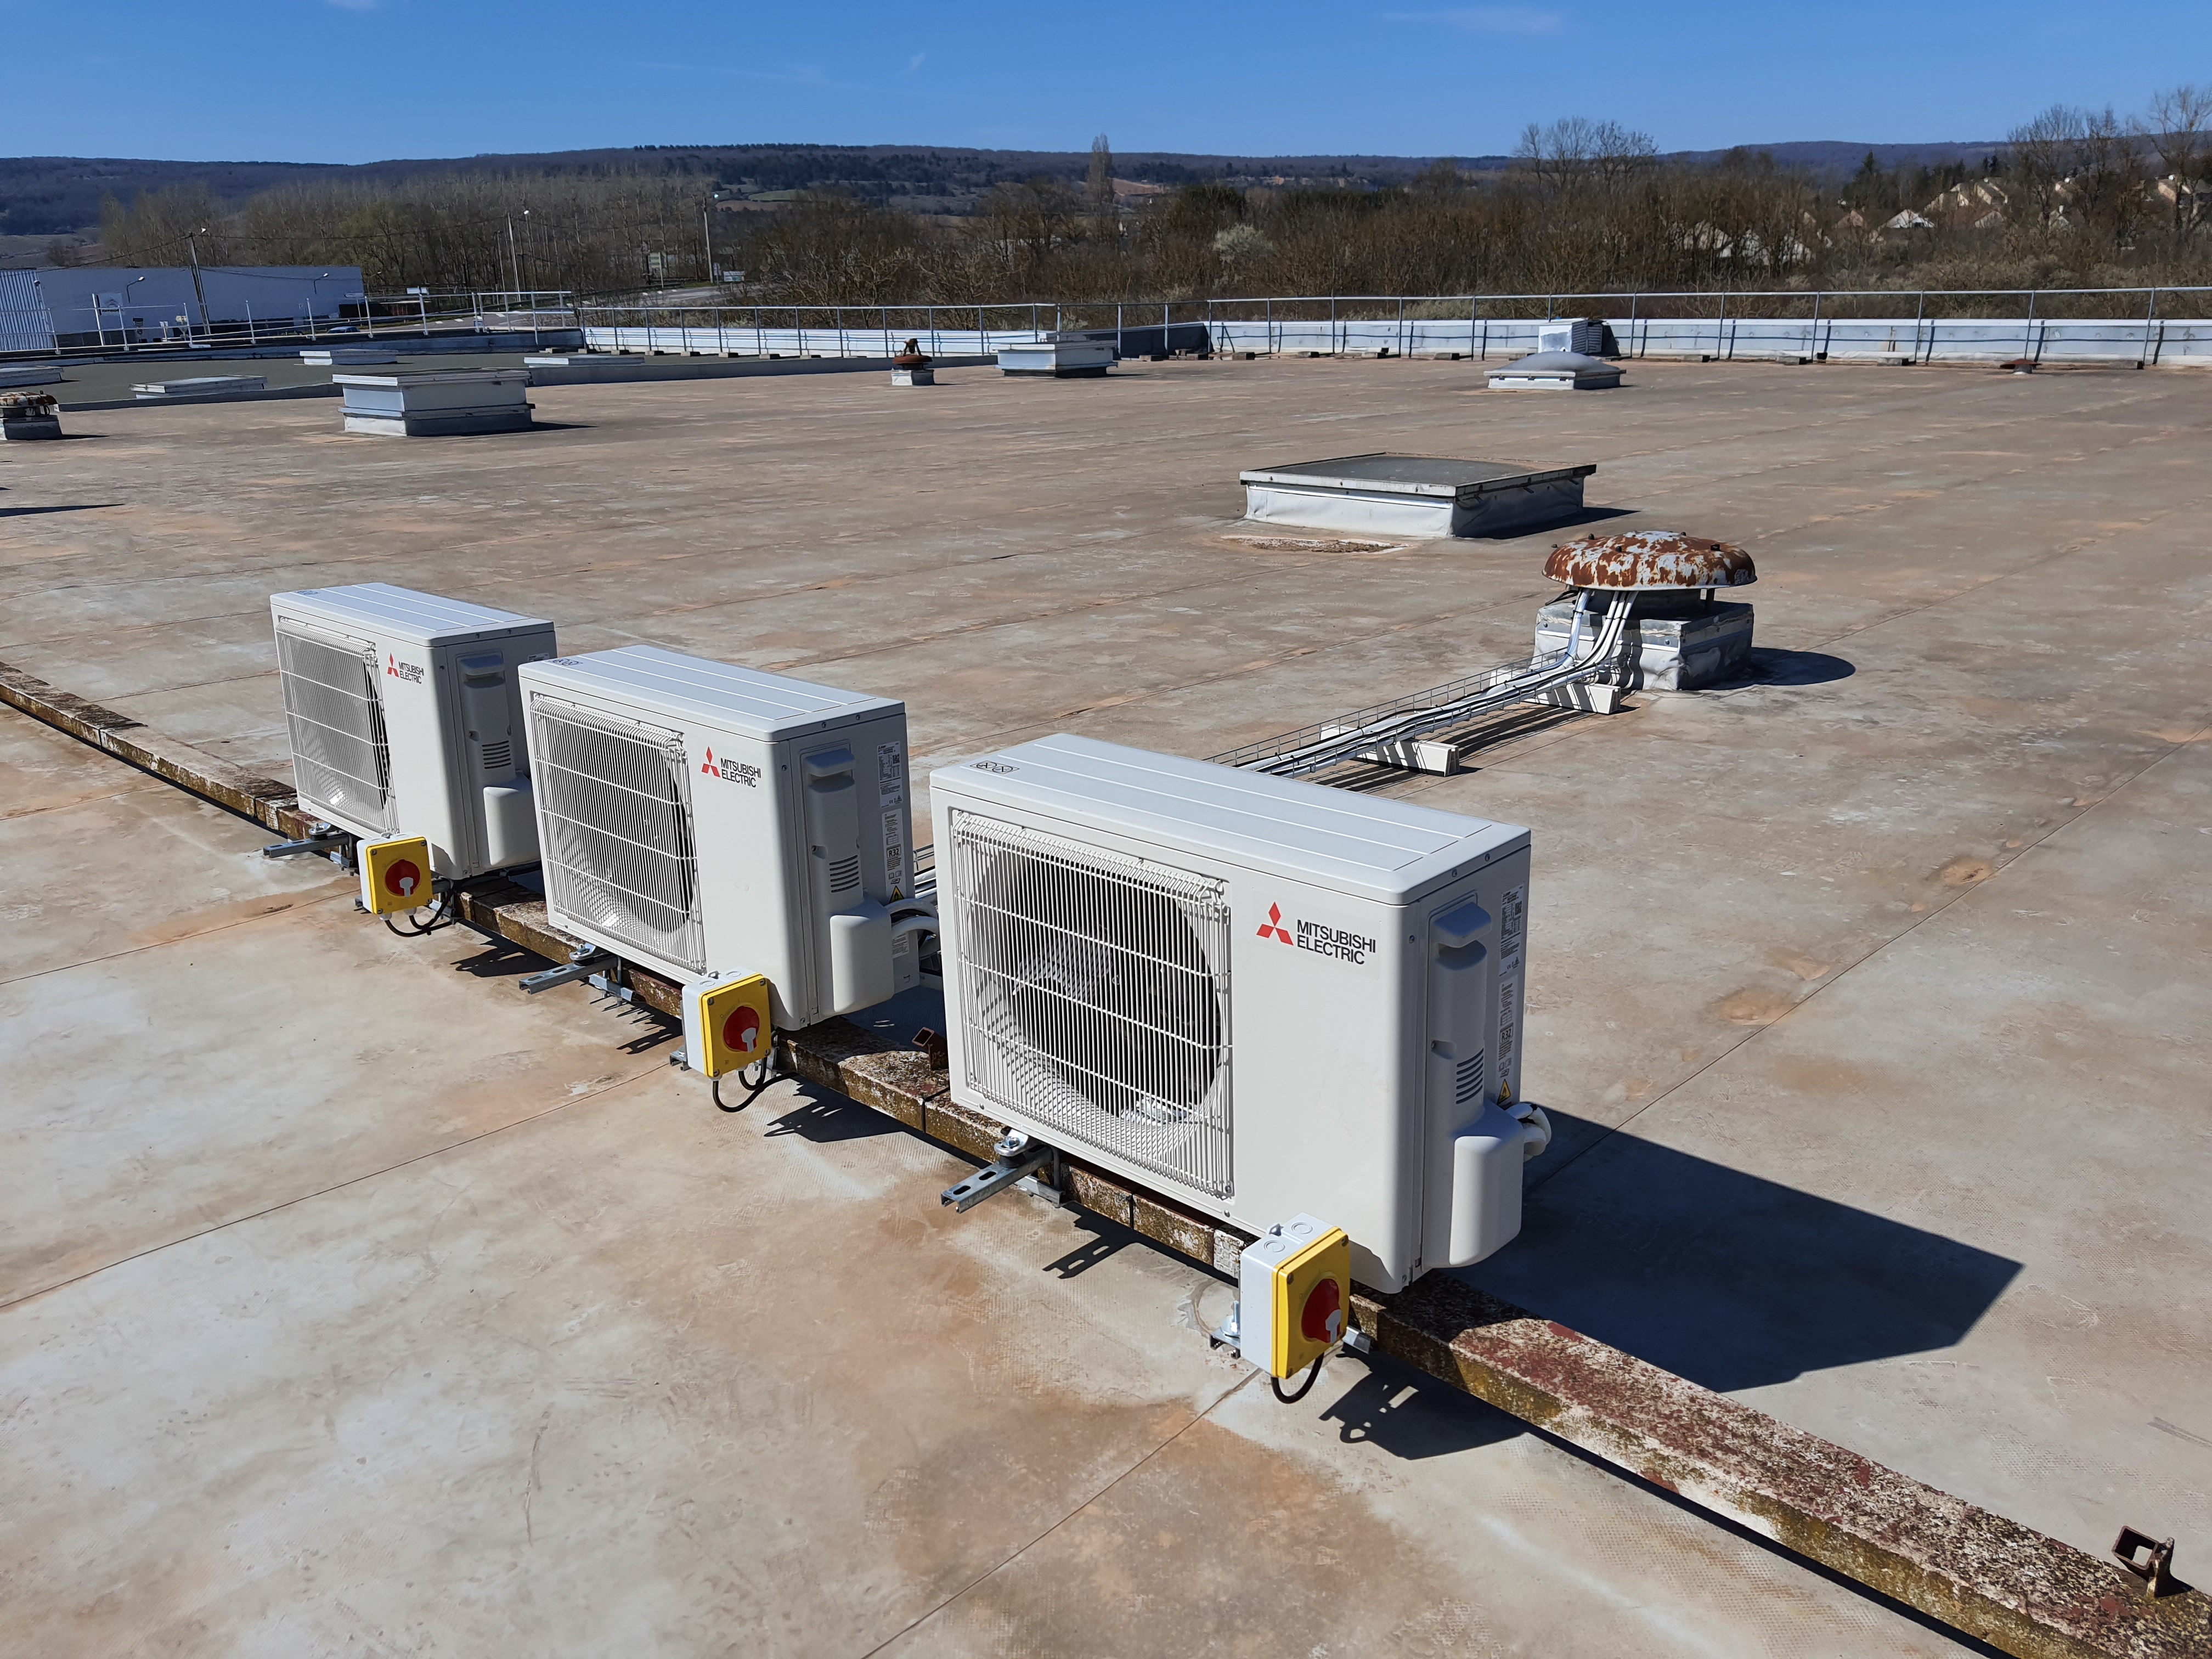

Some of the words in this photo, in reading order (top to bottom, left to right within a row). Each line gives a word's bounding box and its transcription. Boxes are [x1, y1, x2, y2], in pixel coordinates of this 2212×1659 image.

[398, 661, 424, 676] MITSUBISHI
[399, 670, 422, 684] ELECTRIC
[720, 758, 761, 778] MITSUBISHI
[721, 769, 757, 788] ELECTRIC
[889, 848, 900, 857] R32
[1297, 919, 1376, 953] MITSUBISHI
[1297, 934, 1365, 965] ELECTRIC
[1502, 1028, 1511, 1041] R32
